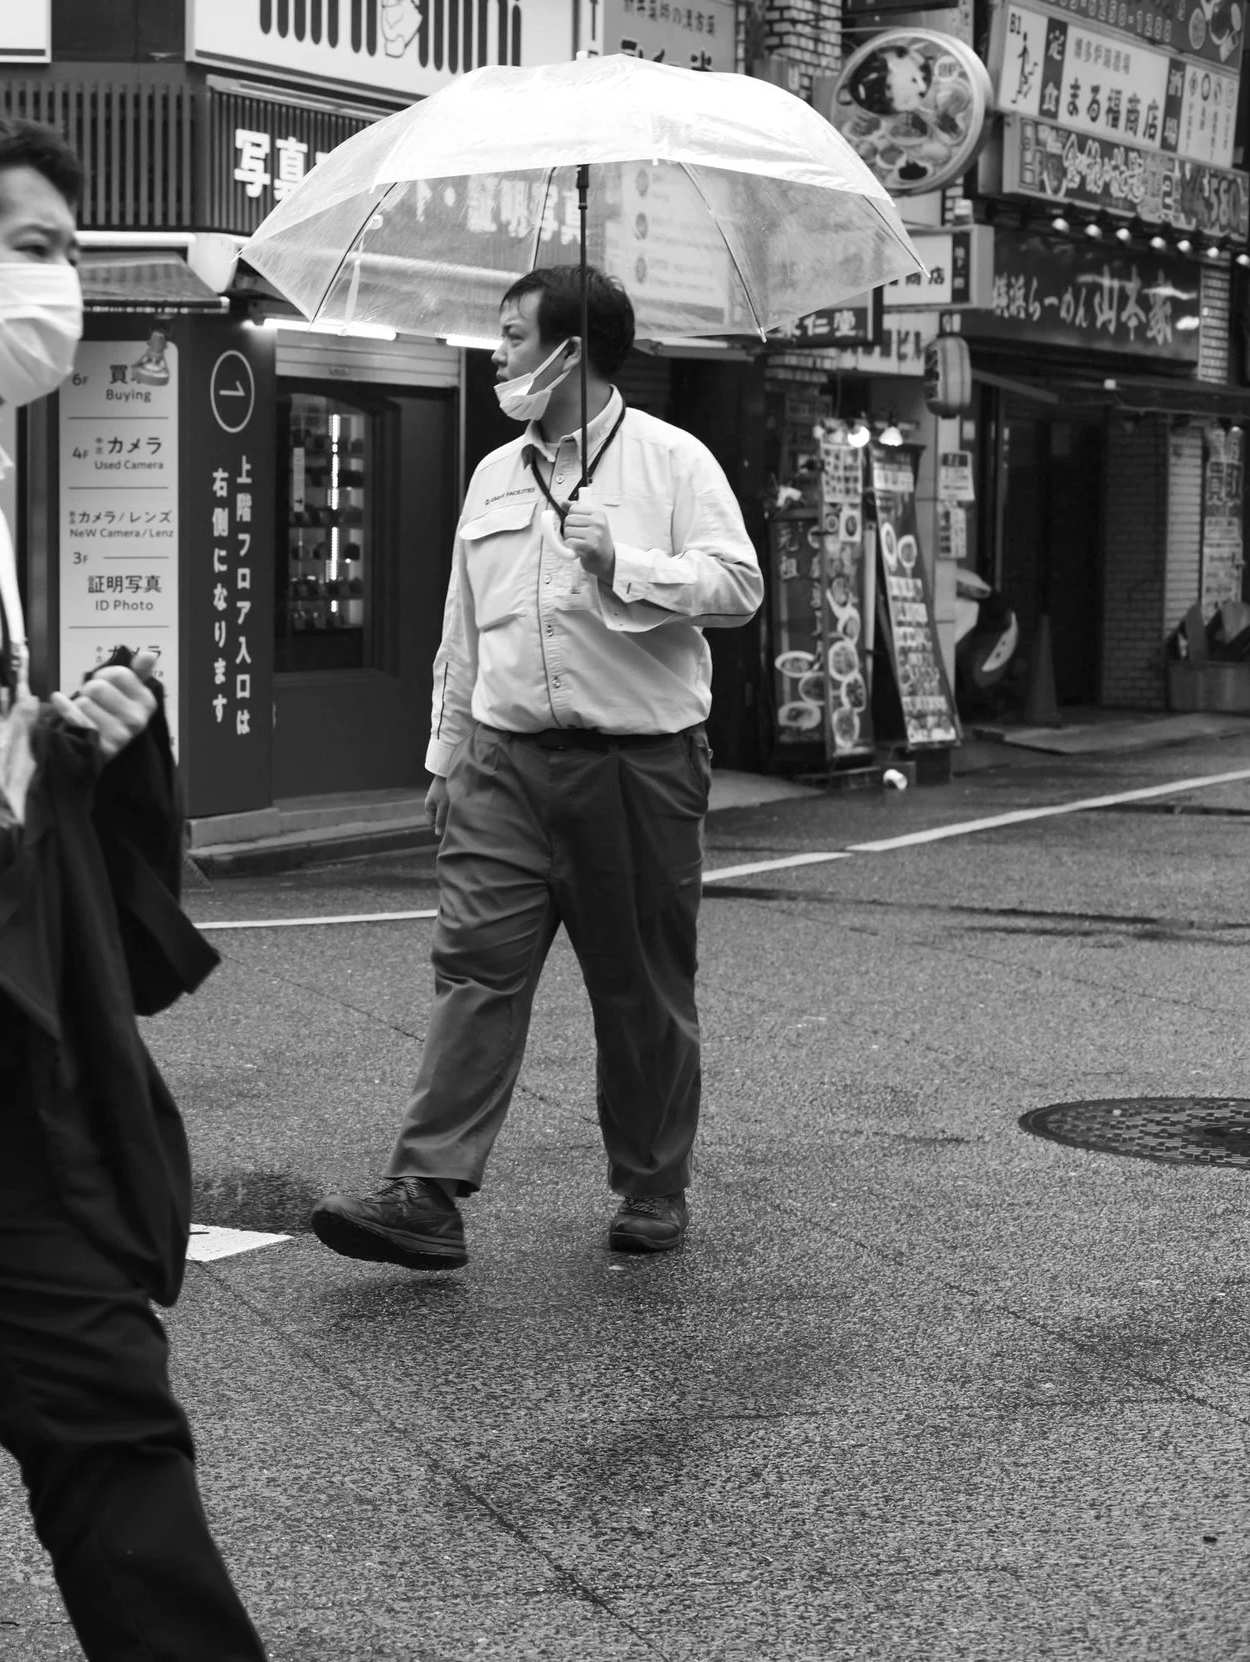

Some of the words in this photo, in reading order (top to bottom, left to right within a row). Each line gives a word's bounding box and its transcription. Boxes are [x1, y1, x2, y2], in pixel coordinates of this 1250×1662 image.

[234, 128, 330, 201] 写真
[72, 373, 89, 387] 6F
[105, 388, 152, 404] Buying
[72, 447, 89, 459] 4F
[107, 437, 162, 455] カメラ
[94, 460, 121, 470] Used
[124, 460, 164, 470] Camera
[72, 551, 88, 565] 3F
[88, 575, 162, 593] 証明写真
[212, 467, 230, 723] 右側になります
[236, 455, 253, 736] 上階フロア入口は
[95, 600, 110, 611] ID
[113, 600, 154, 611] Photo
